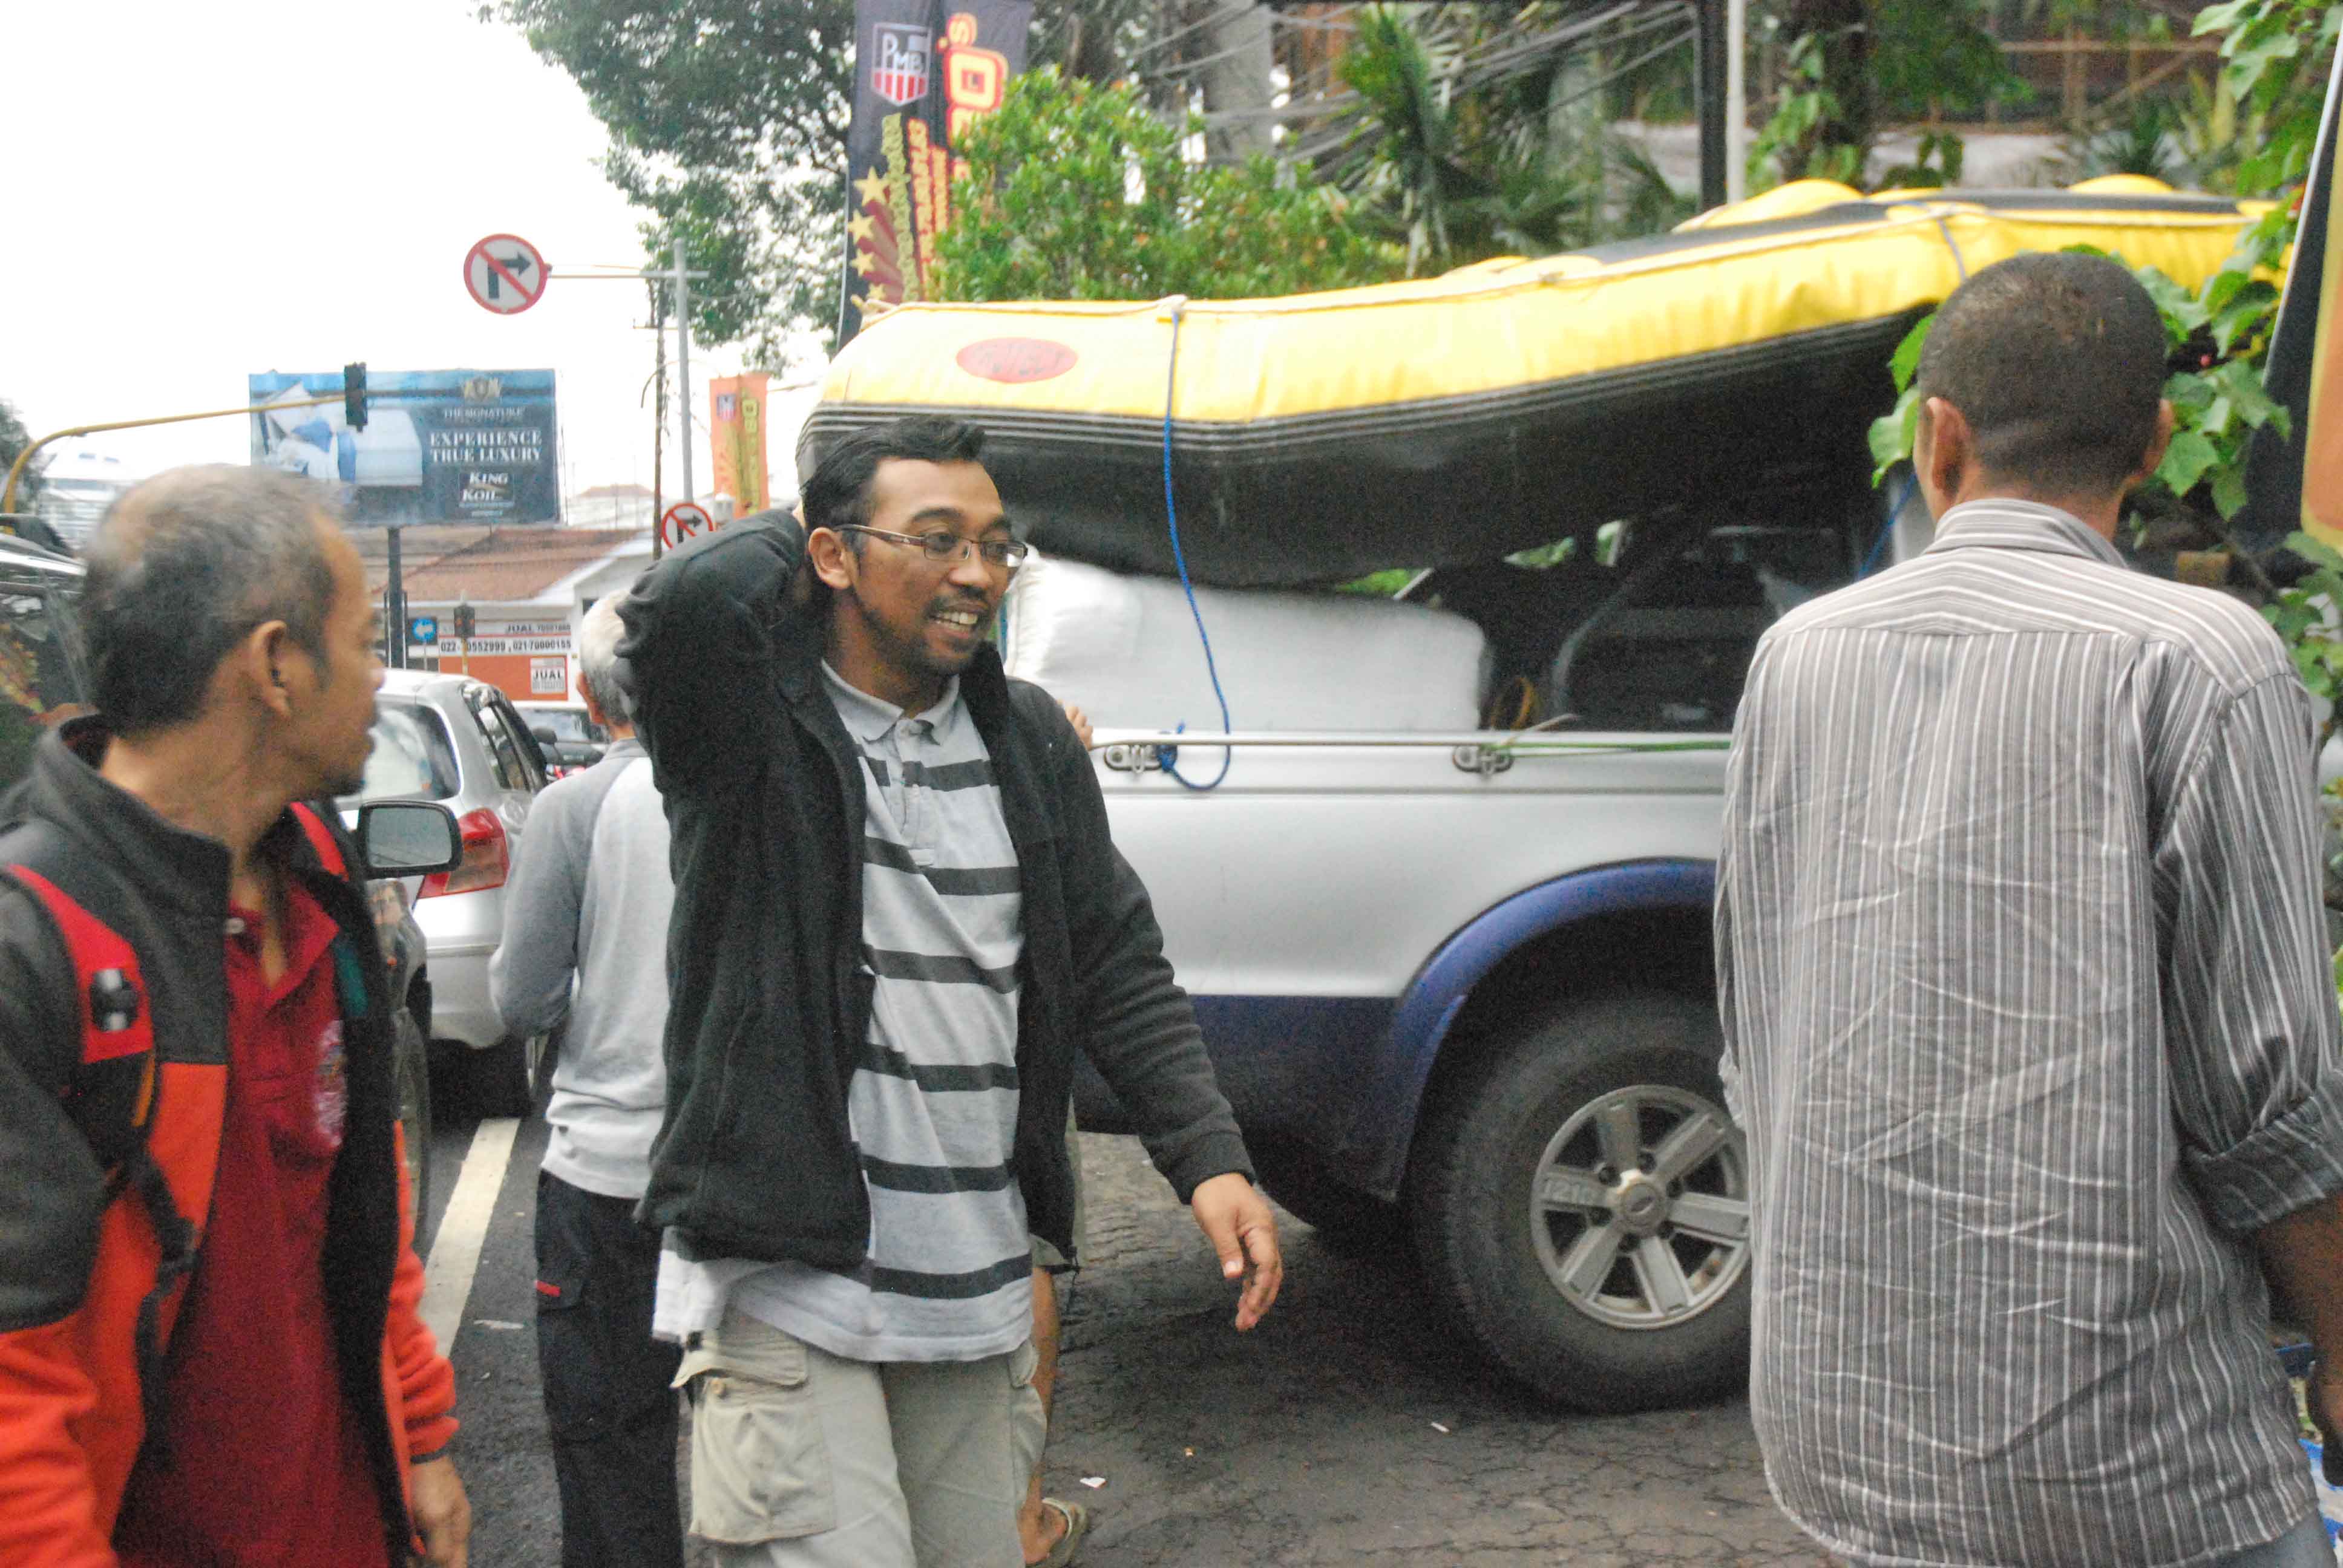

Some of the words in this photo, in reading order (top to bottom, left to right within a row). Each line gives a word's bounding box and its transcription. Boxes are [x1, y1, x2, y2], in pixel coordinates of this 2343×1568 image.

[430, 430, 542, 448] EXPERIENCE
[430, 448, 475, 463] TRUE
[479, 446, 542, 462] LUXURY
[468, 472, 509, 485] KING
[533, 668, 562, 681] JUAL
